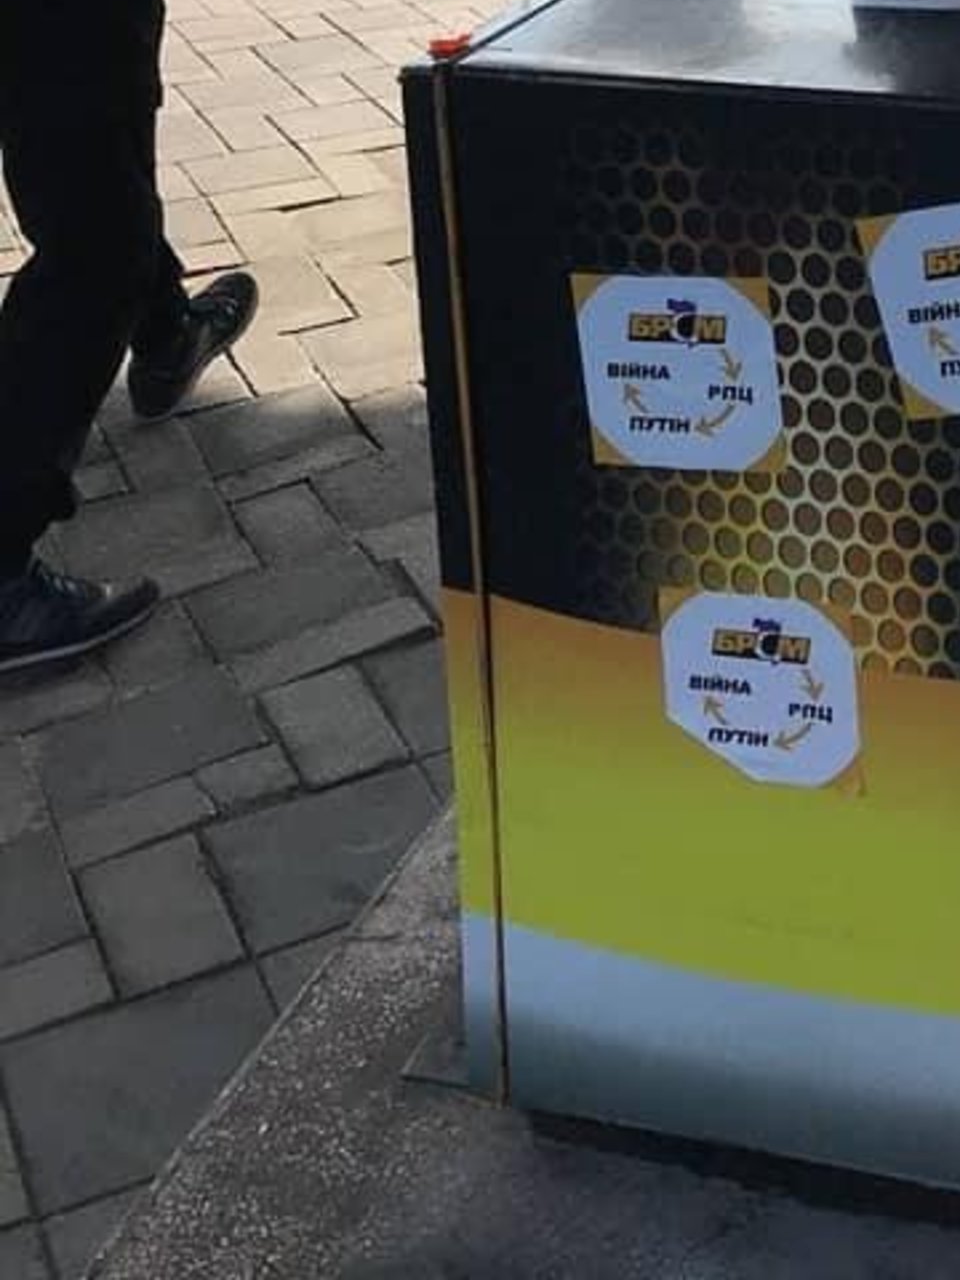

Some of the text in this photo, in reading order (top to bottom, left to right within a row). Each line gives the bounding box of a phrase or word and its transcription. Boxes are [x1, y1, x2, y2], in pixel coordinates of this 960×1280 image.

[607, 362, 670, 380] ВІЙНА
[708, 384, 753, 405] РПЦ
[629, 416, 691, 433] ПУТІН
[688, 675, 752, 696] ВІЙНА
[788, 702, 833, 724] РПЦ
[708, 727, 769, 747] ПУТІН
